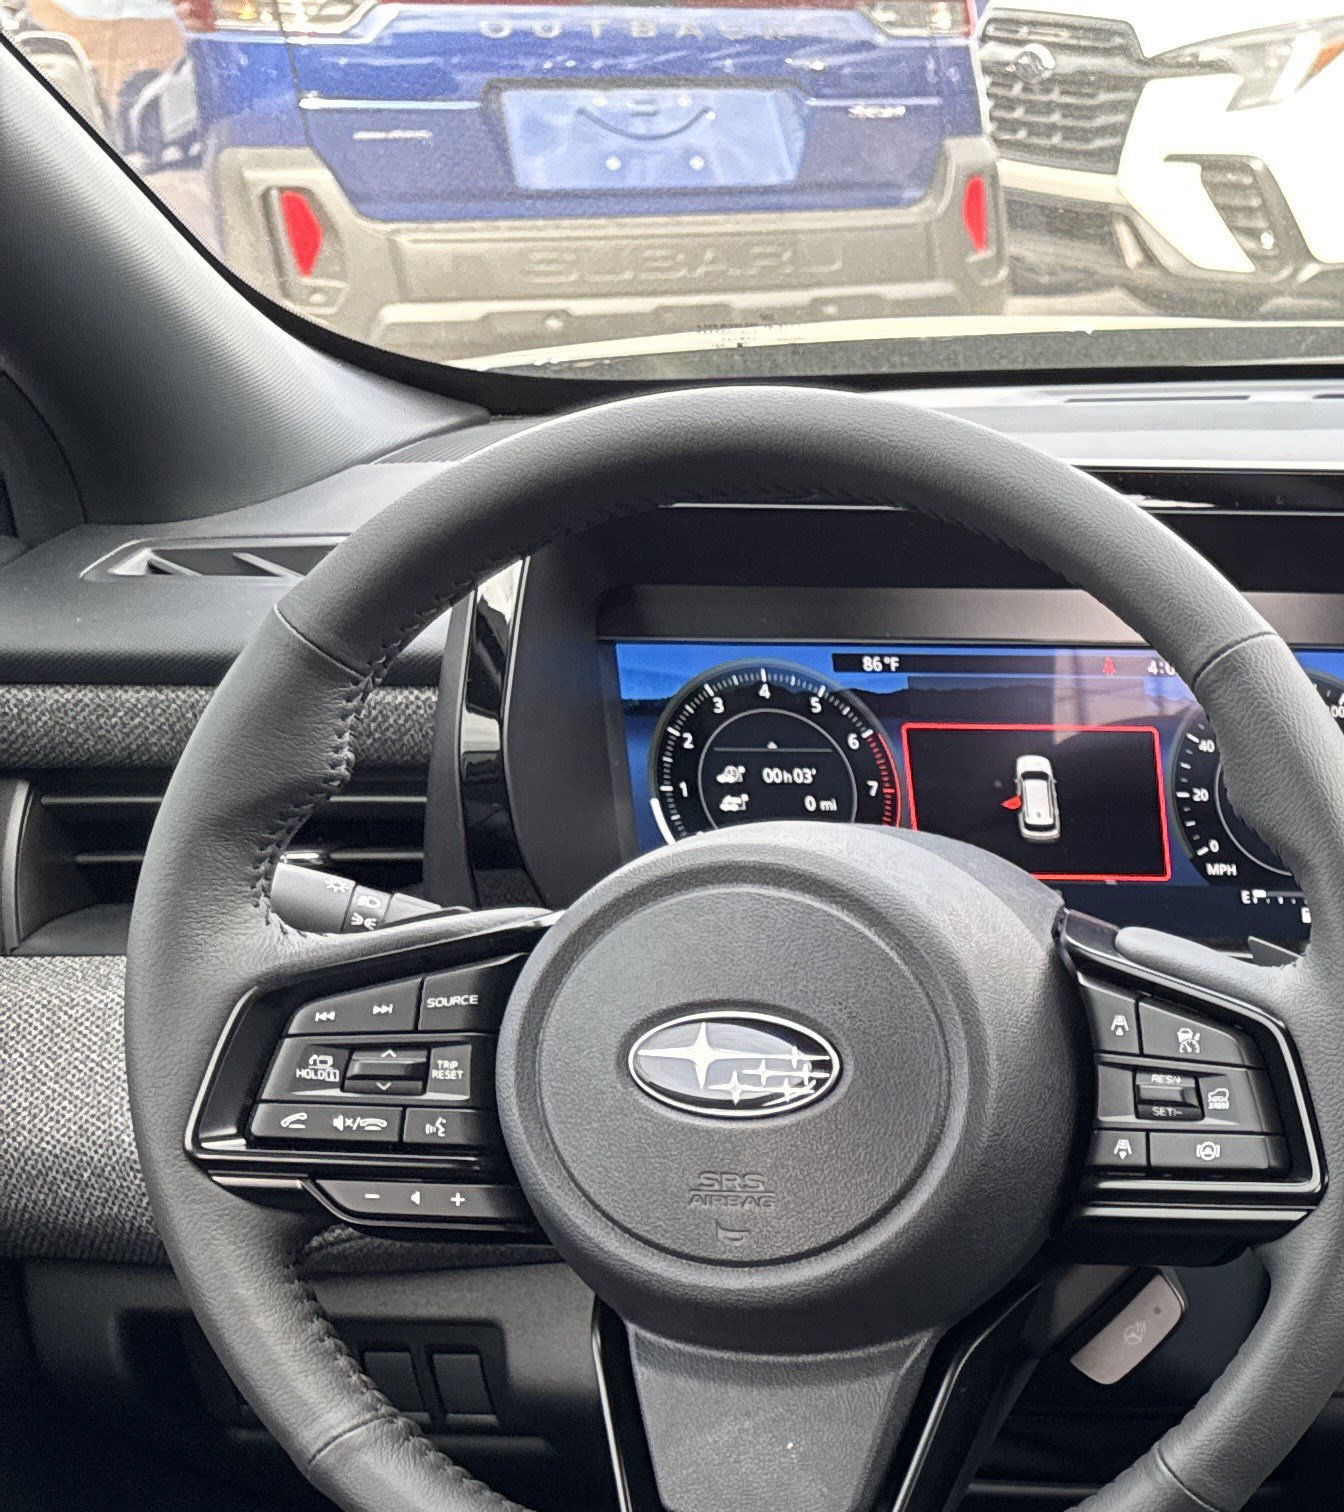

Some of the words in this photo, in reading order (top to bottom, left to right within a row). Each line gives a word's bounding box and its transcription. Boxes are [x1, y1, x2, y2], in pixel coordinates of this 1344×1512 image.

[525, 236, 843, 284] SUBARU
[1147, 660, 1176, 676] 4:0
[758, 685, 771, 700] 4
[713, 697, 725, 713] 3
[810, 698, 822, 713] 5
[682, 733, 694, 749] 2
[847, 734, 860, 749] 6
[1198, 740, 1215, 753] 40
[679, 782, 688, 797] 1
[867, 781, 878, 796] 7
[1192, 787, 1209, 801] 20
[804, 795, 817, 812] 0
[1208, 839, 1220, 853] 0
[1206, 862, 1238, 877] MPH
[1240, 889, 1251, 904] E
[426, 994, 478, 1008] SOURCE
[436, 1060, 459, 1069] TRIP
[296, 1068, 325, 1079] HOLD
[432, 1069, 464, 1080] RESET
[698, 1171, 766, 1191] SRS
[688, 1194, 775, 1207] AIRBAG
